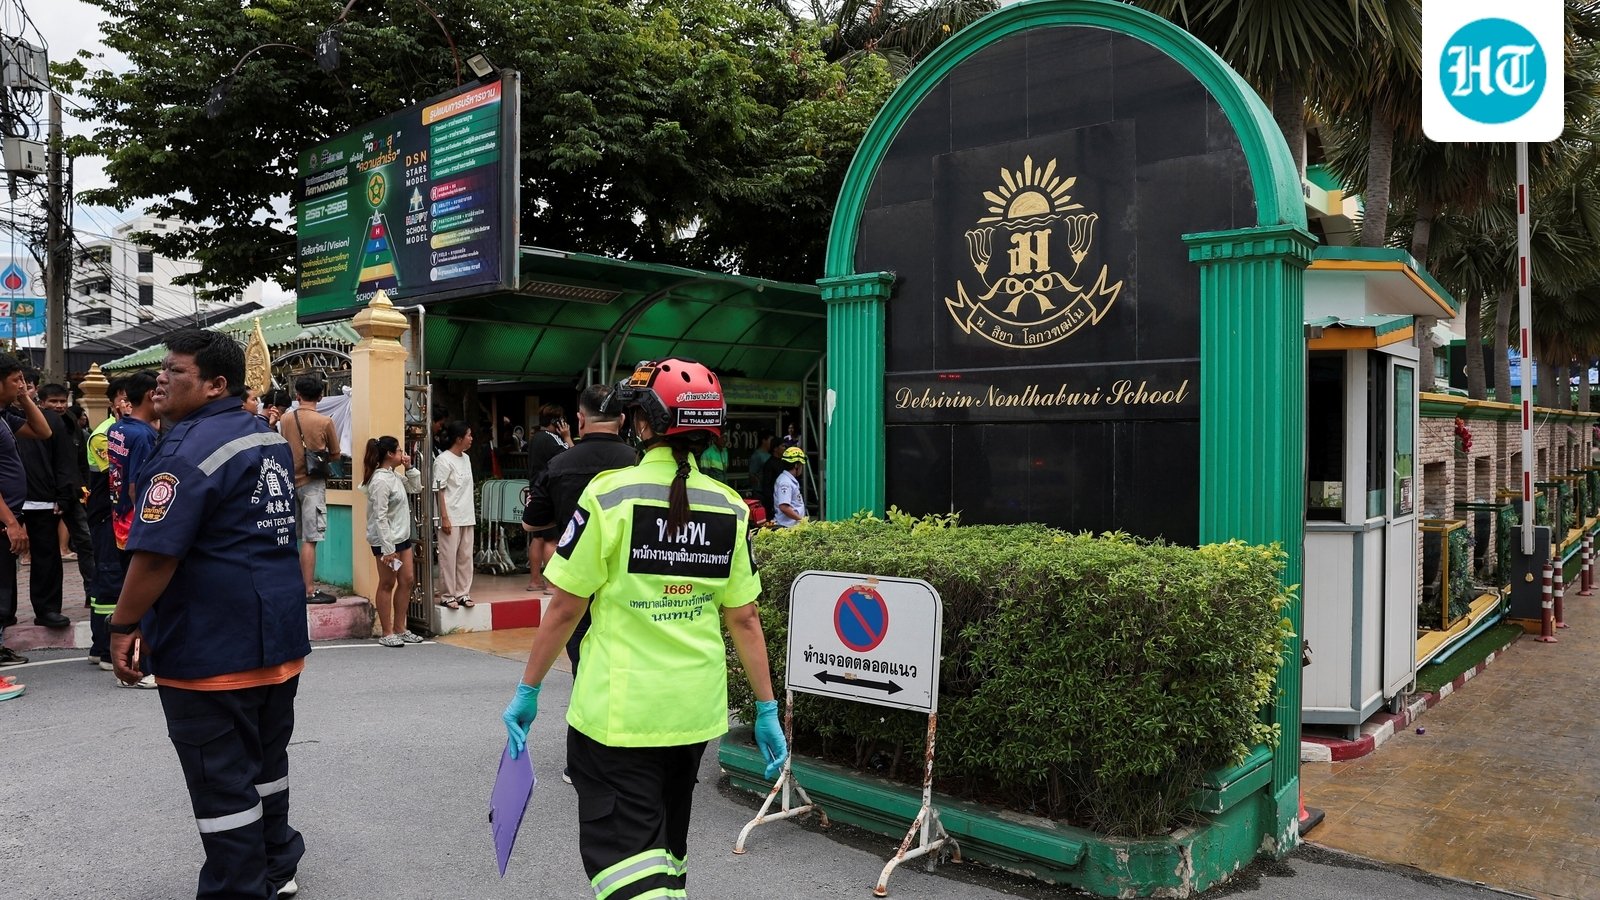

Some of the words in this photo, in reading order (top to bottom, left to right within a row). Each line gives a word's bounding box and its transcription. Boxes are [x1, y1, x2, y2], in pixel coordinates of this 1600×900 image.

[405, 150, 427, 167] DSN
[405, 164, 427, 178] STARS
[405, 175, 428, 187] MODEL
[305, 201, 348, 221] 2567-2569
[405, 211, 428, 226] HAPPY
[405, 224, 428, 236] SCHOOL
[405, 236, 428, 245] MODEL
[991, 324, 1014, 343] สิยา
[895, 386, 977, 409] Debsirin
[974, 383, 1104, 407] Nonthaburi
[1106, 379, 1189, 405] School
[256, 519, 273, 529] POH
[632, 544, 732, 567] พนักงานฉุกเฉินการแพทย์
[663, 583, 693, 595] 1669
[651, 605, 703, 622] นนทบุรี
[803, 643, 917, 679] ห้ามจอดตลอดแนว
